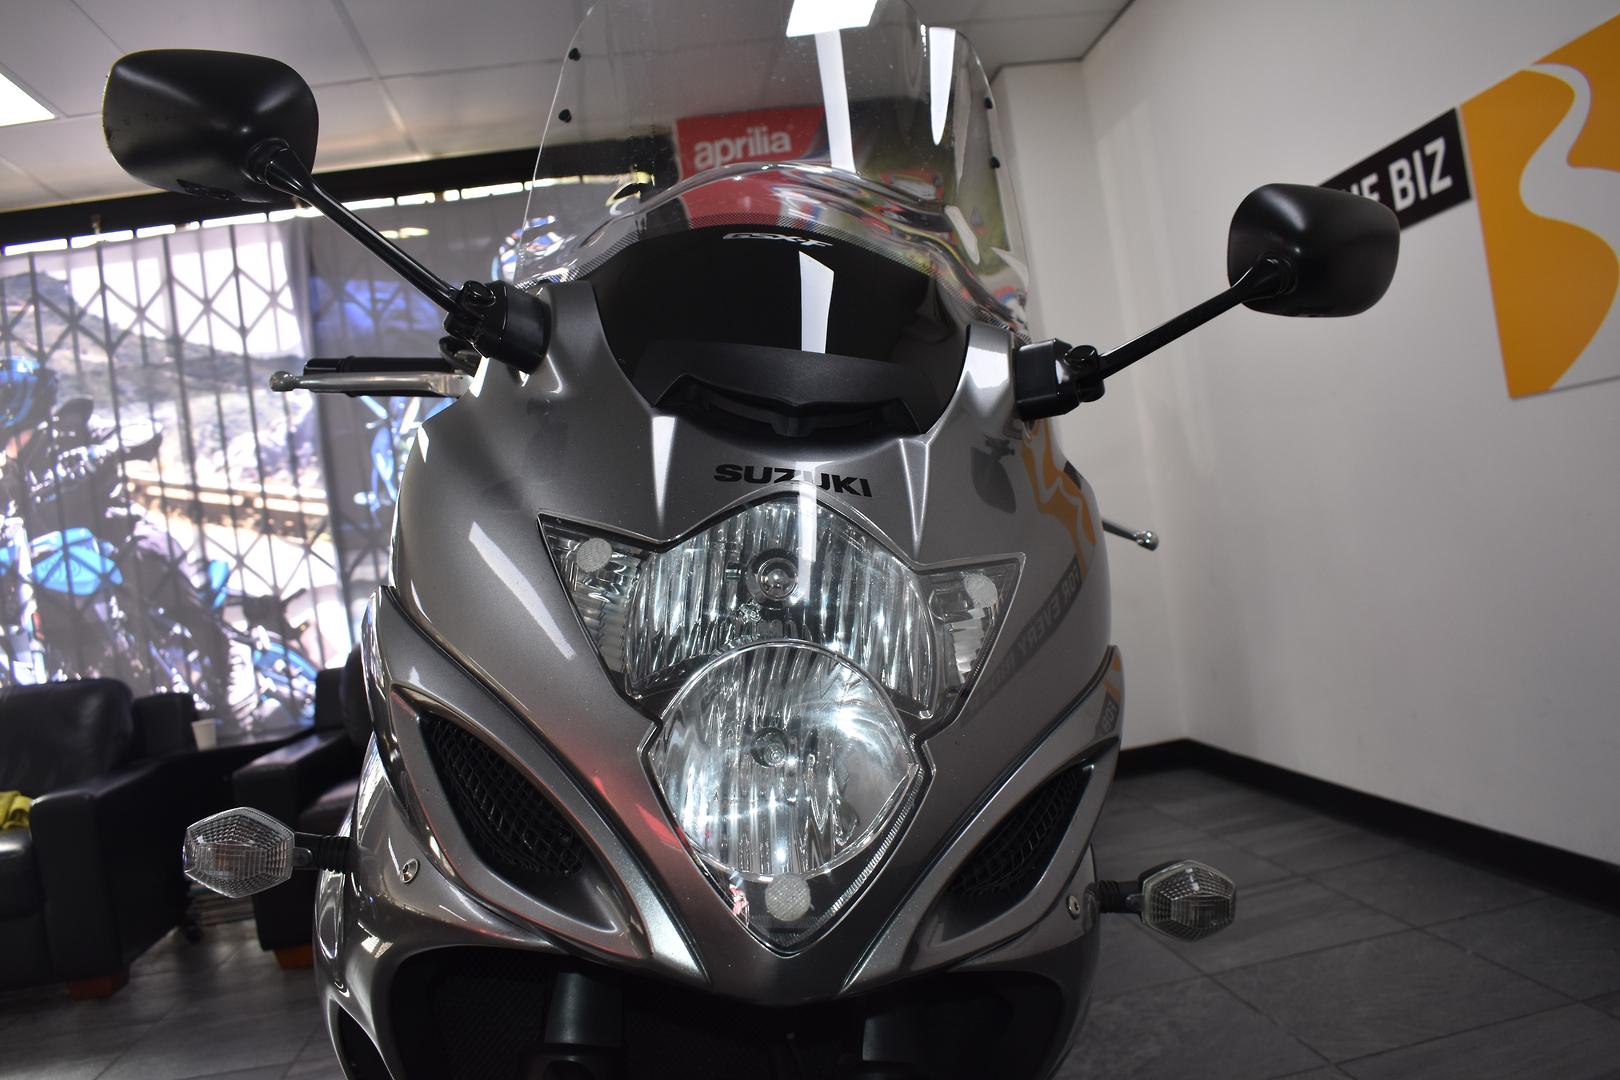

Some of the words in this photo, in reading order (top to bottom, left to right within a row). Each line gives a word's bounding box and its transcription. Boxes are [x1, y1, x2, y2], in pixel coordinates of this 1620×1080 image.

[694, 126, 792, 169] aprilia
[1388, 136, 1453, 213] BIZ
[713, 464, 873, 498] SUZUKI
